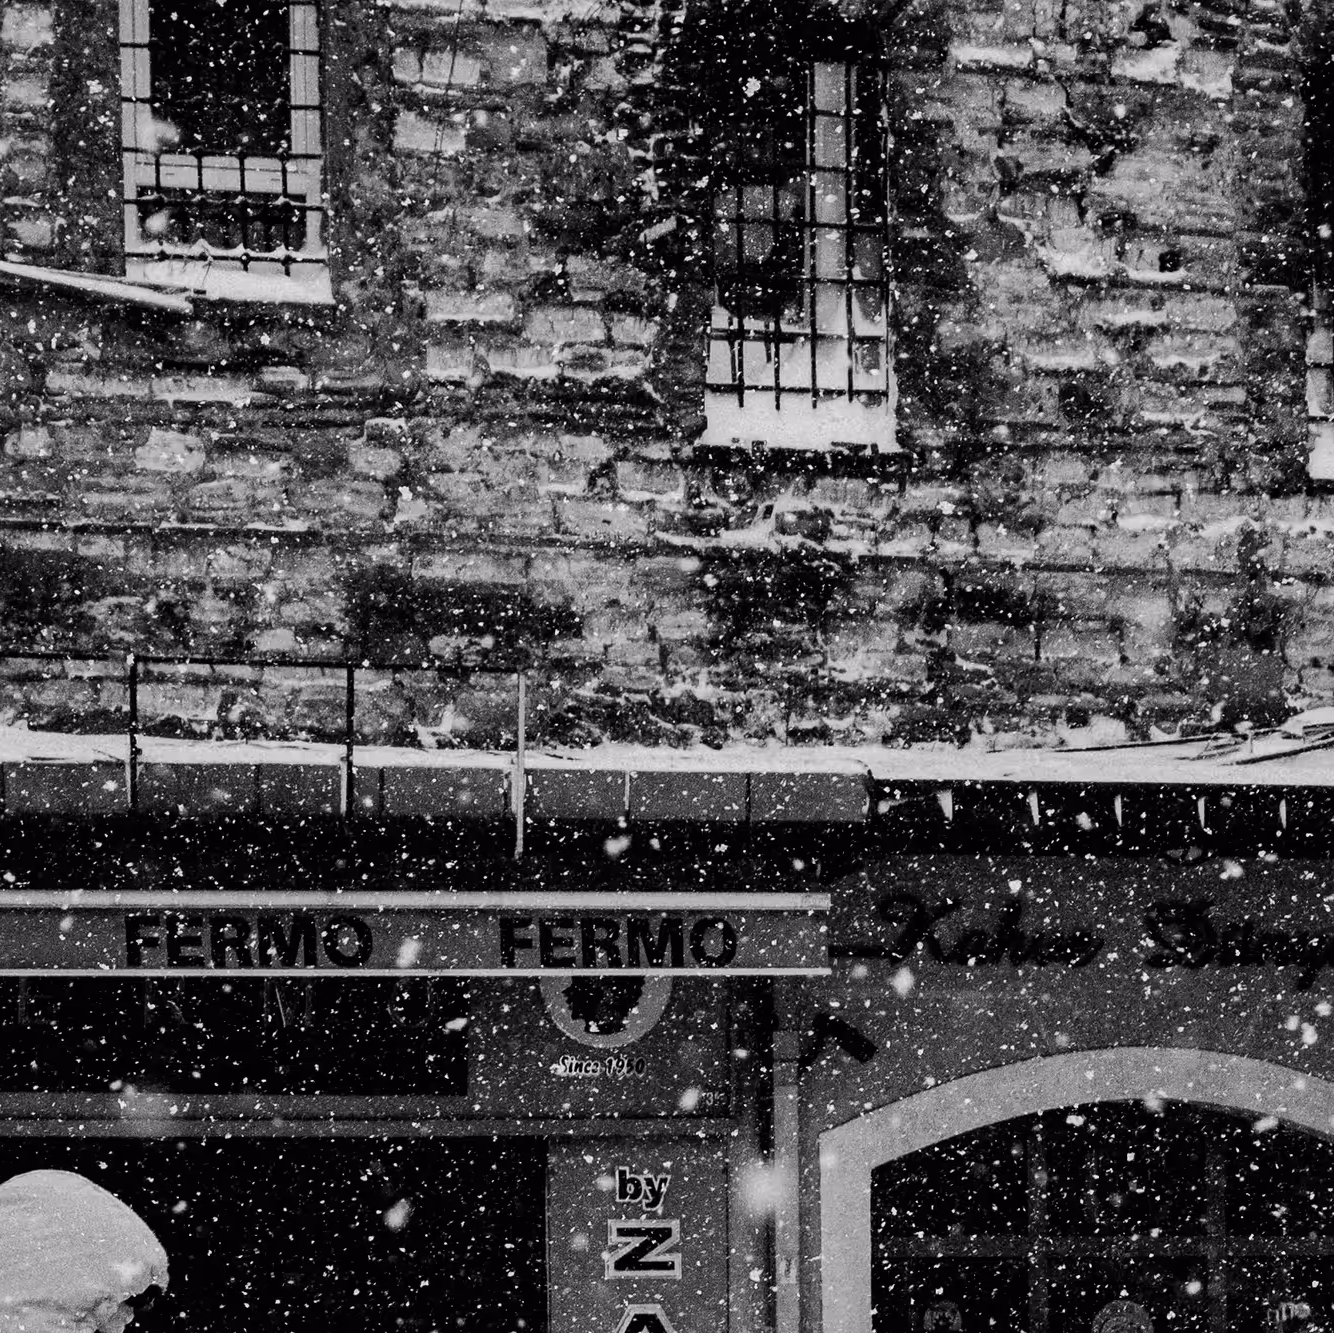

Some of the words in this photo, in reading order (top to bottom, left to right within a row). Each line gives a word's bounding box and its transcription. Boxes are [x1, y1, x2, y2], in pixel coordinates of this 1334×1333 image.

[124, 915, 373, 968] FERMO
[499, 916, 738, 968] FERMO
[559, 1055, 600, 1076] Since
[605, 1056, 646, 1076] 1950
[615, 1167, 671, 1208] by
